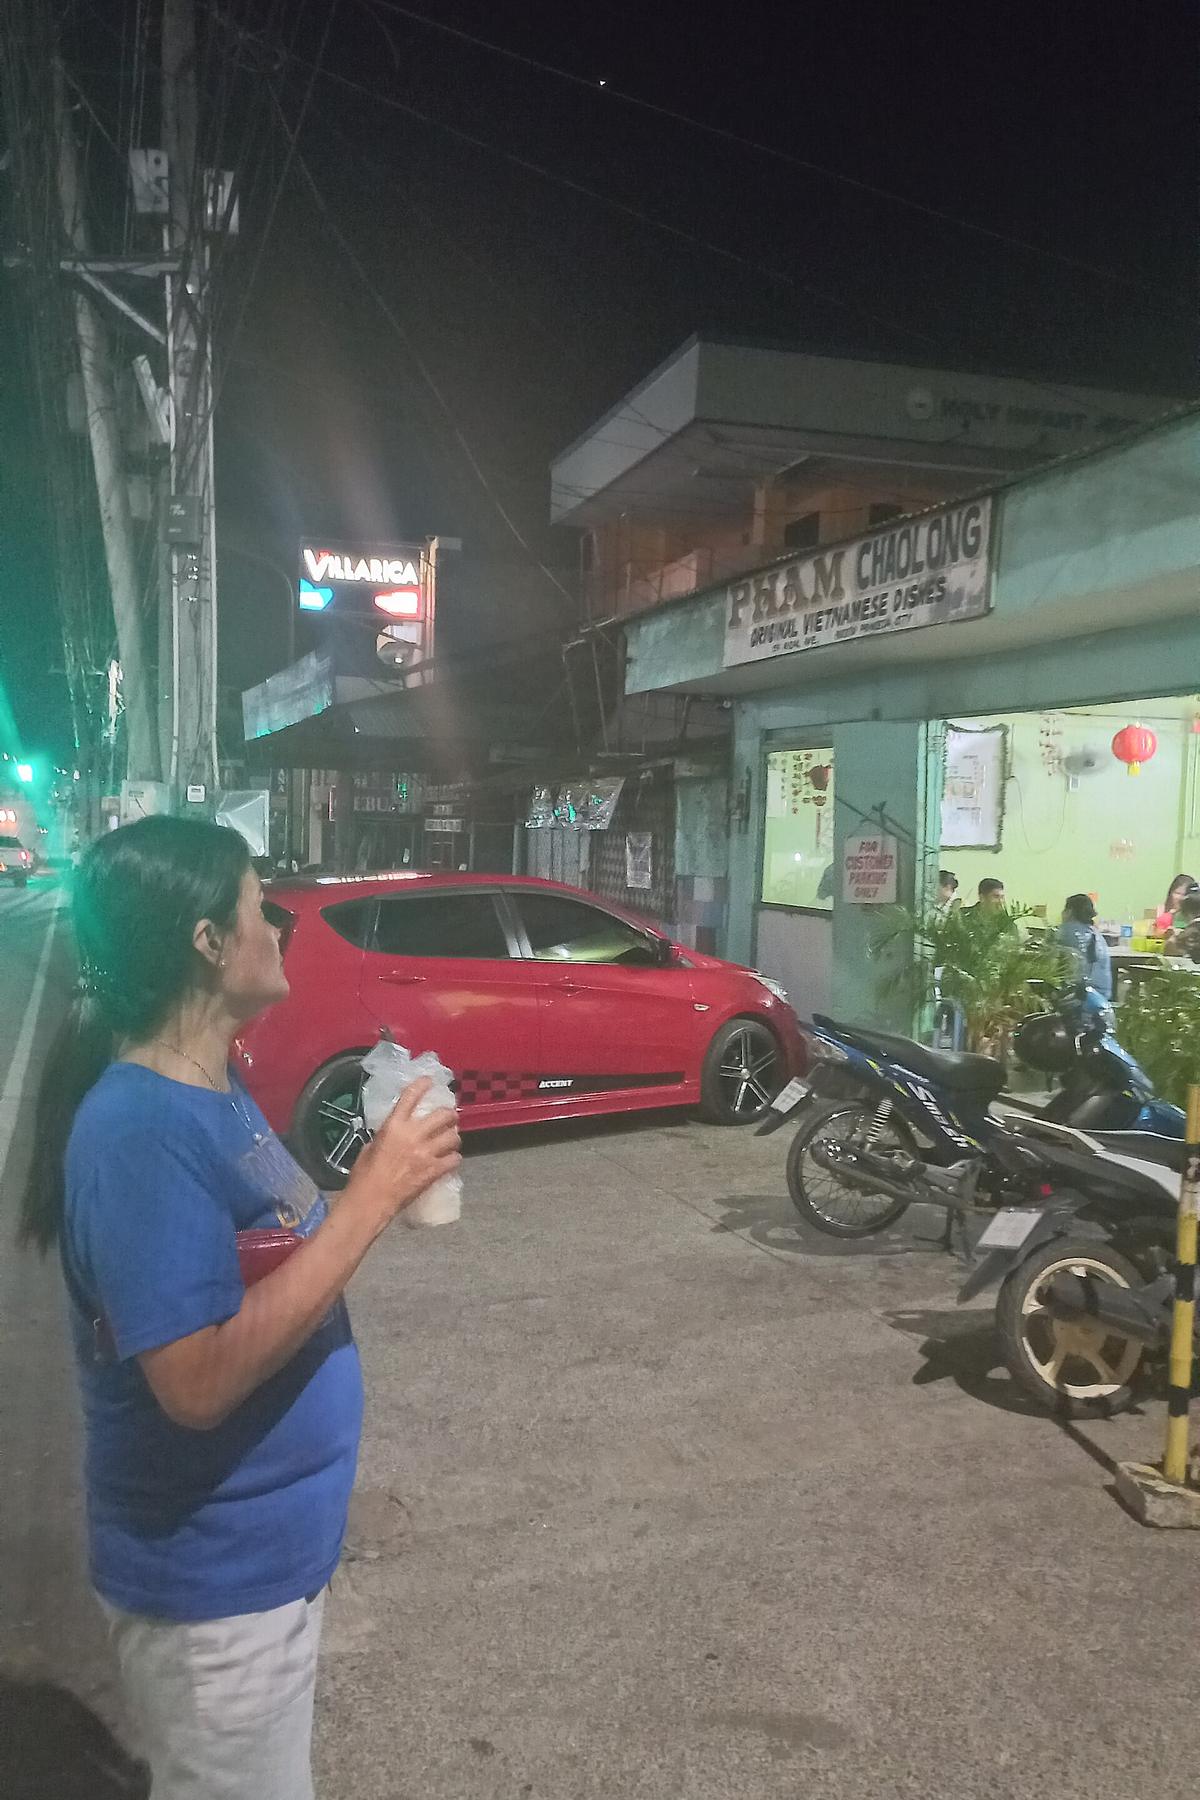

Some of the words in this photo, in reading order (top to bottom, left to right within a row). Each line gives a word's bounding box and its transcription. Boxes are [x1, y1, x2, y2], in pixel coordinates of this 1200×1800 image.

[303, 548, 419, 585] VILLARICA
[729, 551, 846, 628] PHAM
[856, 505, 982, 591] CHAOLONG
[803, 592, 888, 635] VIETNAMESE
[538, 1079, 574, 1089] ACCENT
